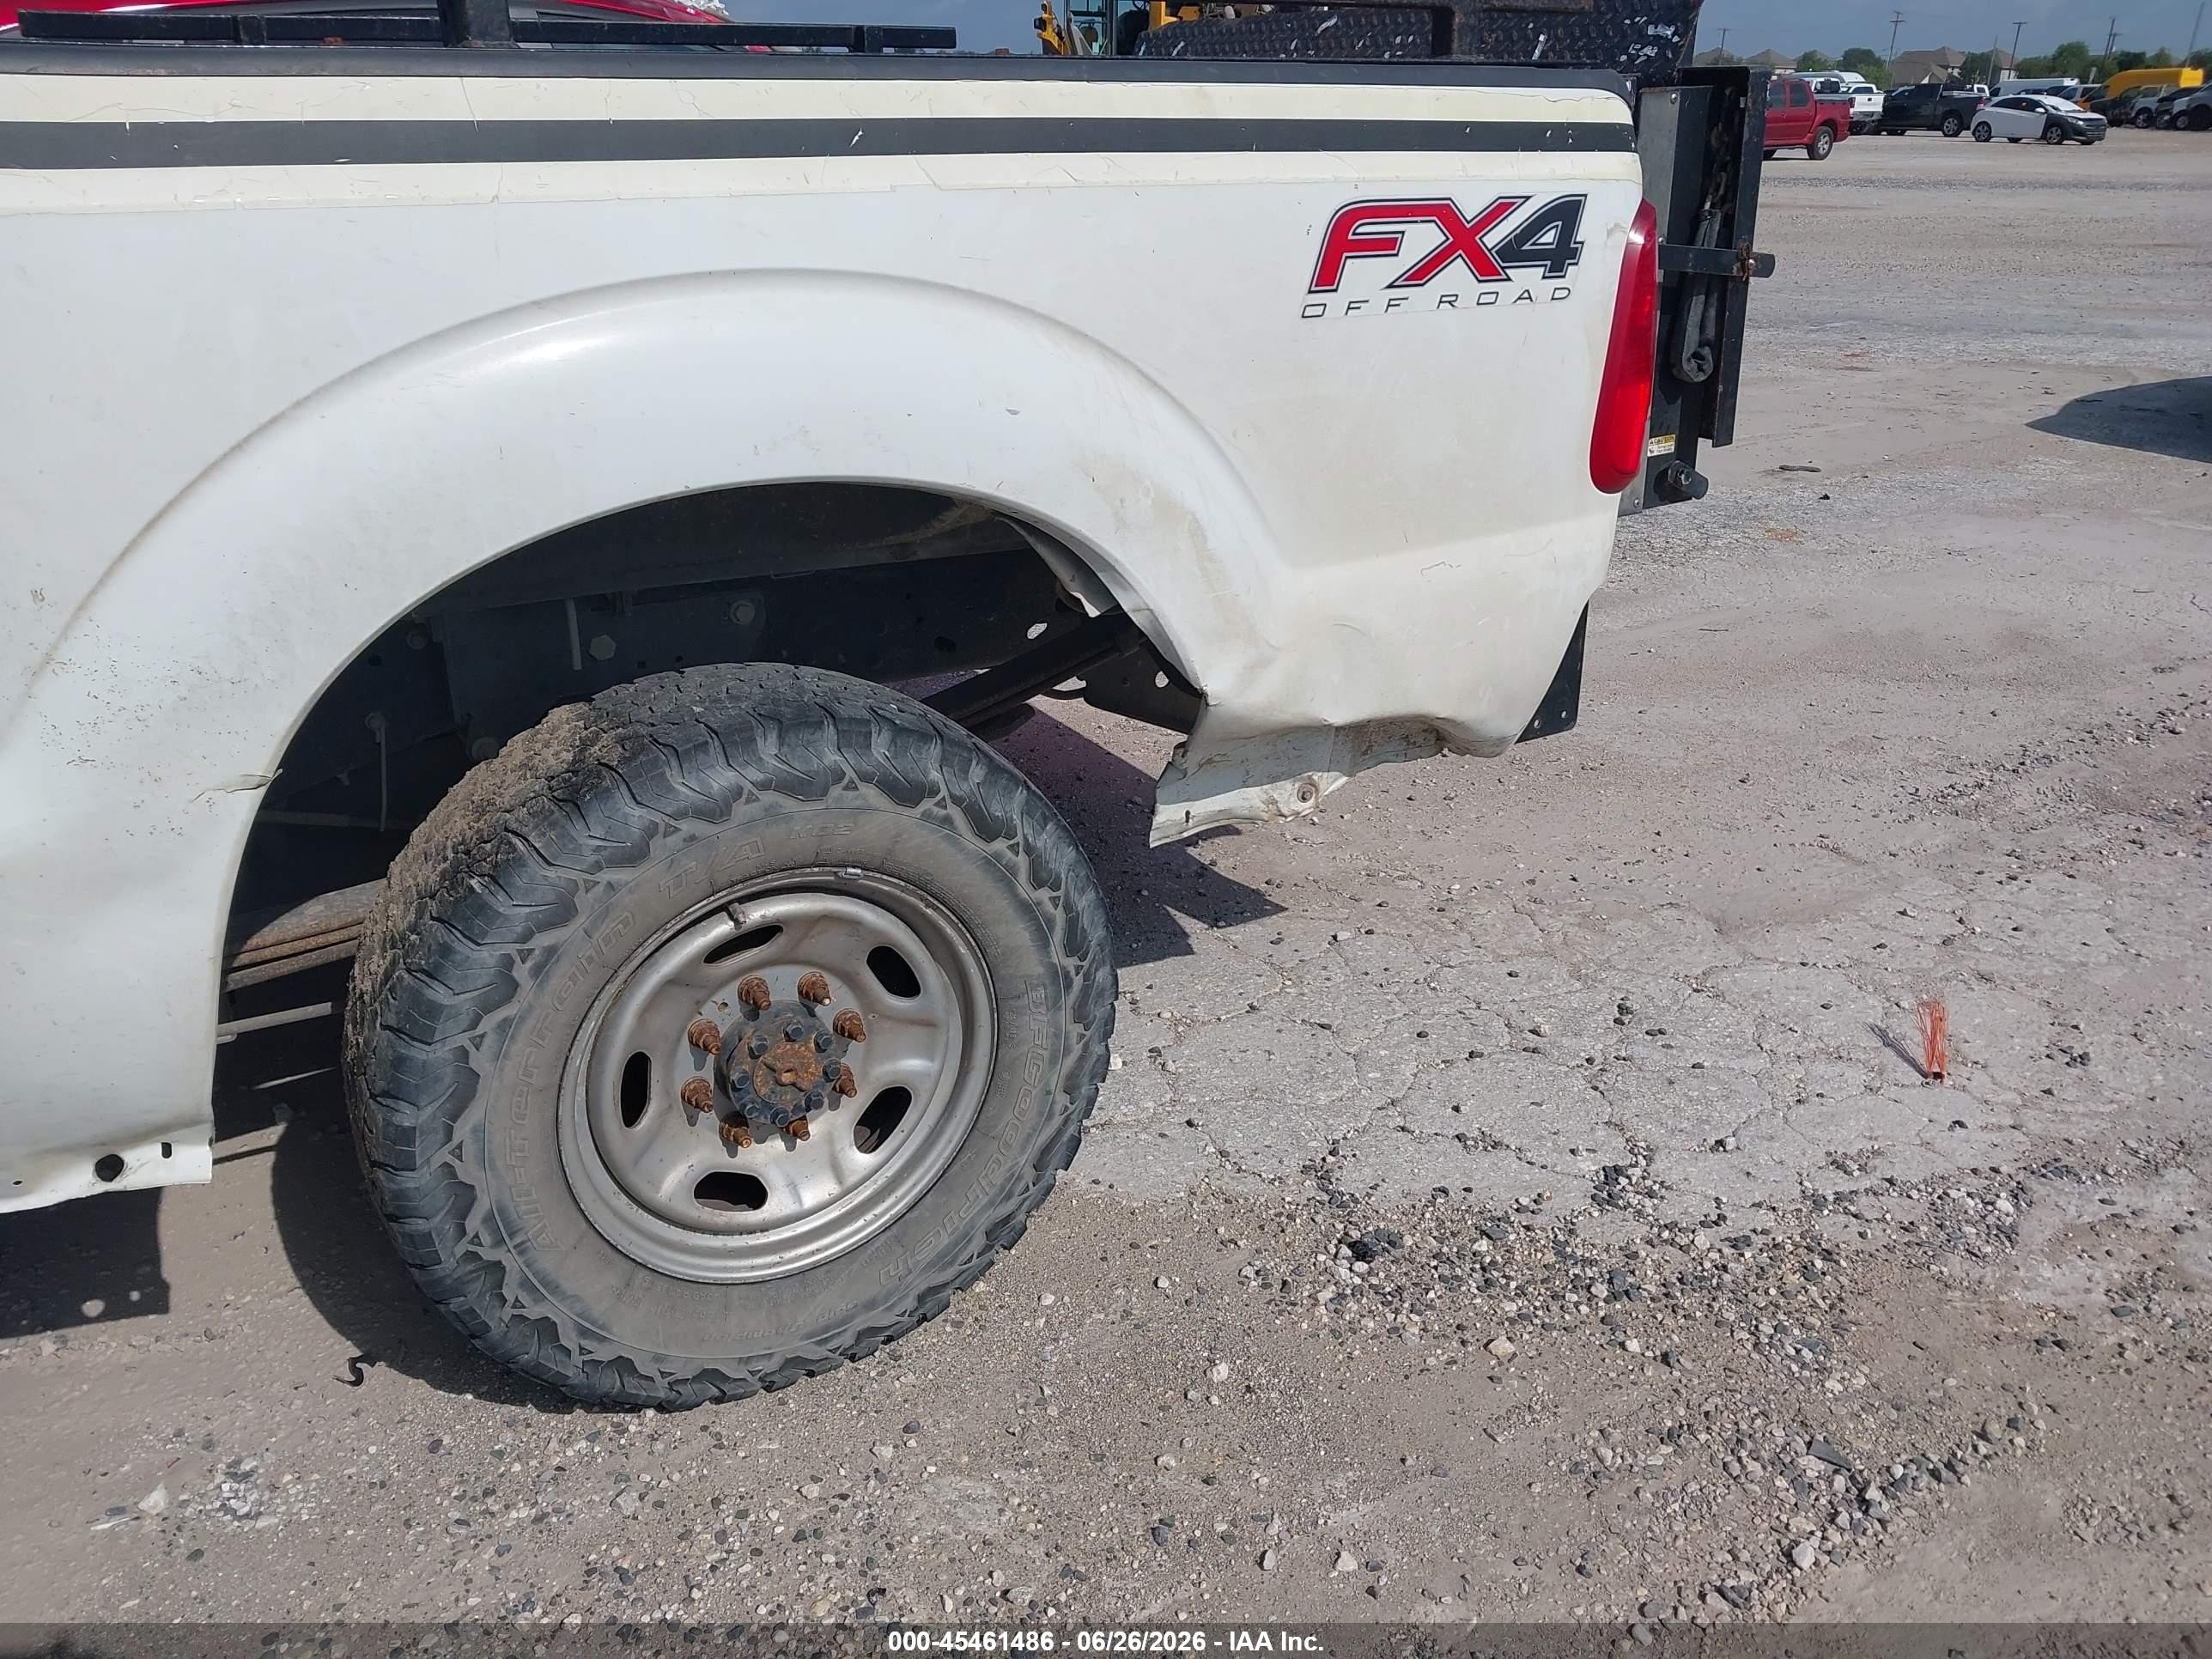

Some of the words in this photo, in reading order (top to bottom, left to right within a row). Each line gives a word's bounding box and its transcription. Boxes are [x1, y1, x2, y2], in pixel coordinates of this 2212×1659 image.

[1307, 193, 1589, 294] FX4
[1301, 297, 1410, 319] OFF
[1436, 287, 1571, 311] ROAD
